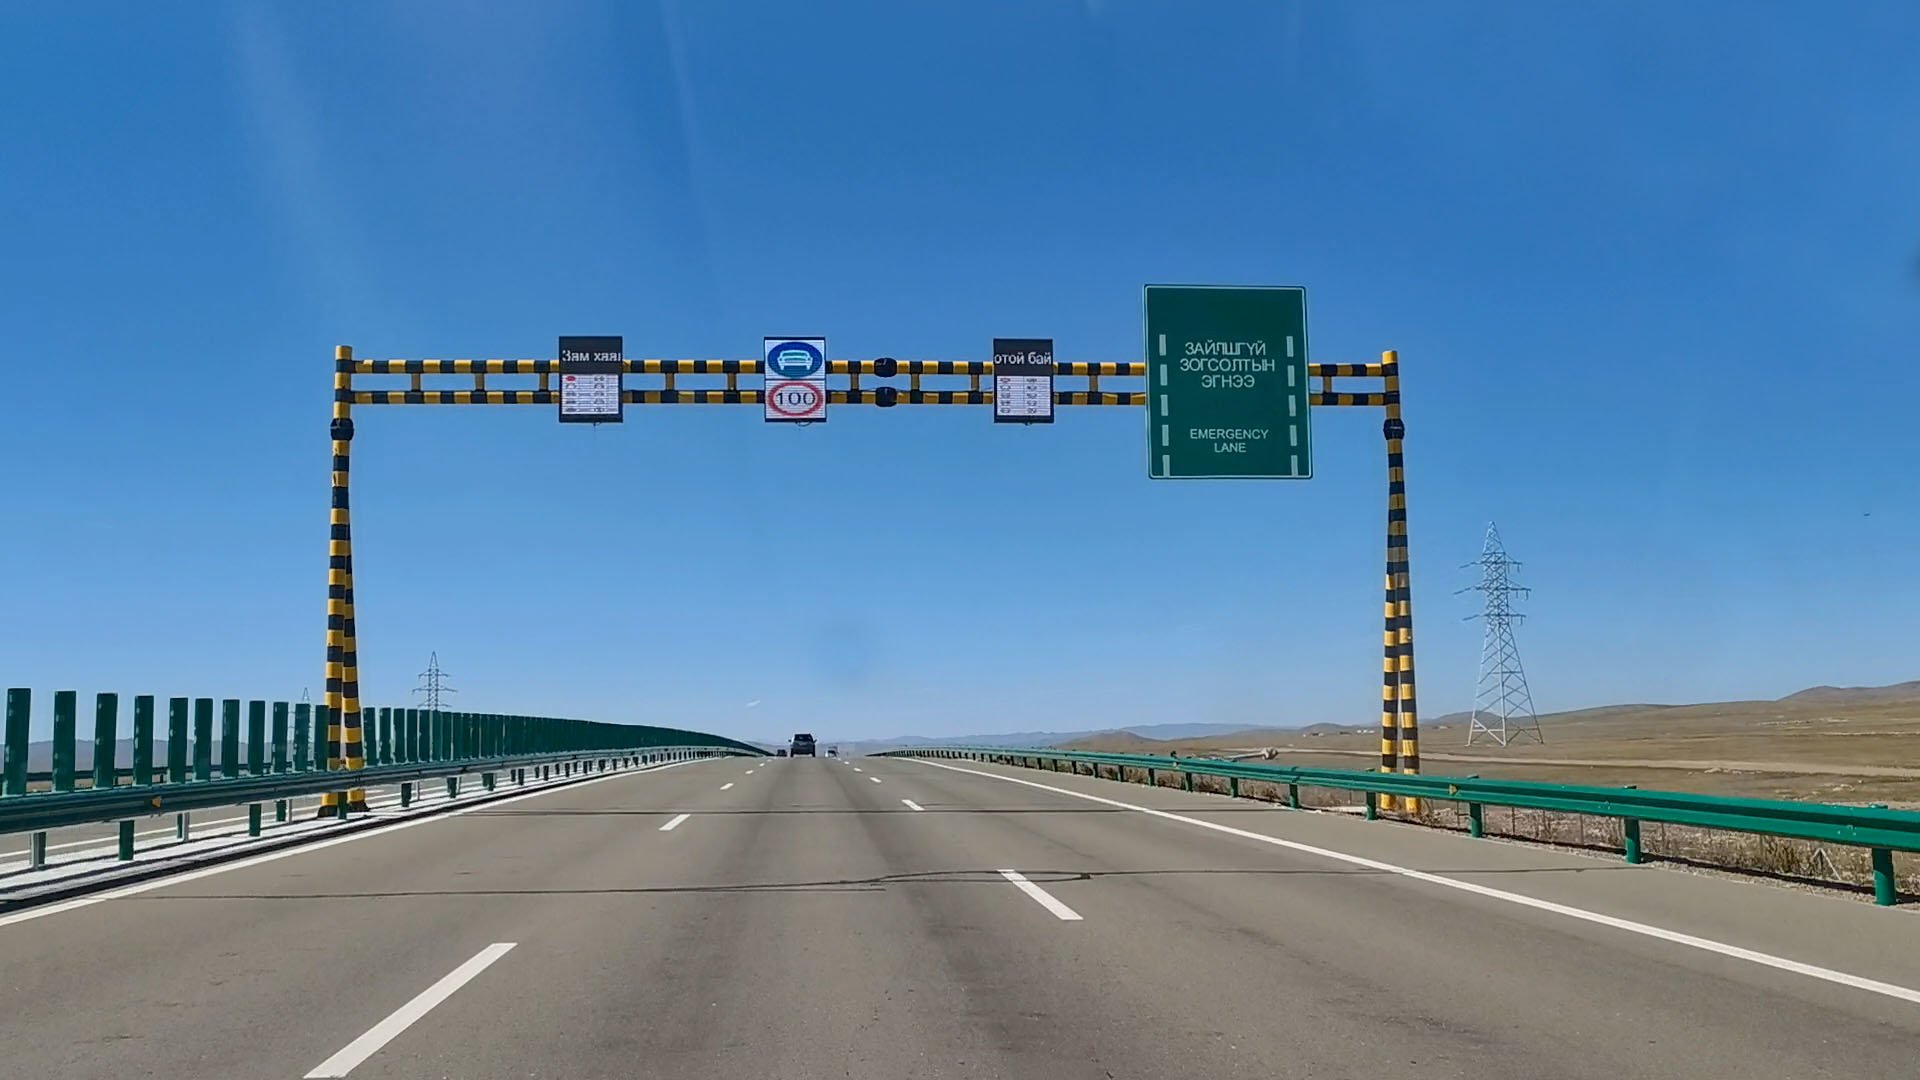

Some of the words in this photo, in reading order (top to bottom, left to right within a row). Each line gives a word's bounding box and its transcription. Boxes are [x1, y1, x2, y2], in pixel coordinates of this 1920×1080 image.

[561, 349, 590, 362] Зам
[993, 352, 1025, 365] отой
[1027, 351, 1052, 365] бай
[1179, 358, 1276, 372] ЗОГСОЛТЫН
[1200, 374, 1256, 388] ЭГНЭЭ
[775, 392, 816, 406] 100
[1189, 428, 1269, 440] EMERGENCY
[1213, 442, 1247, 453] LANE
